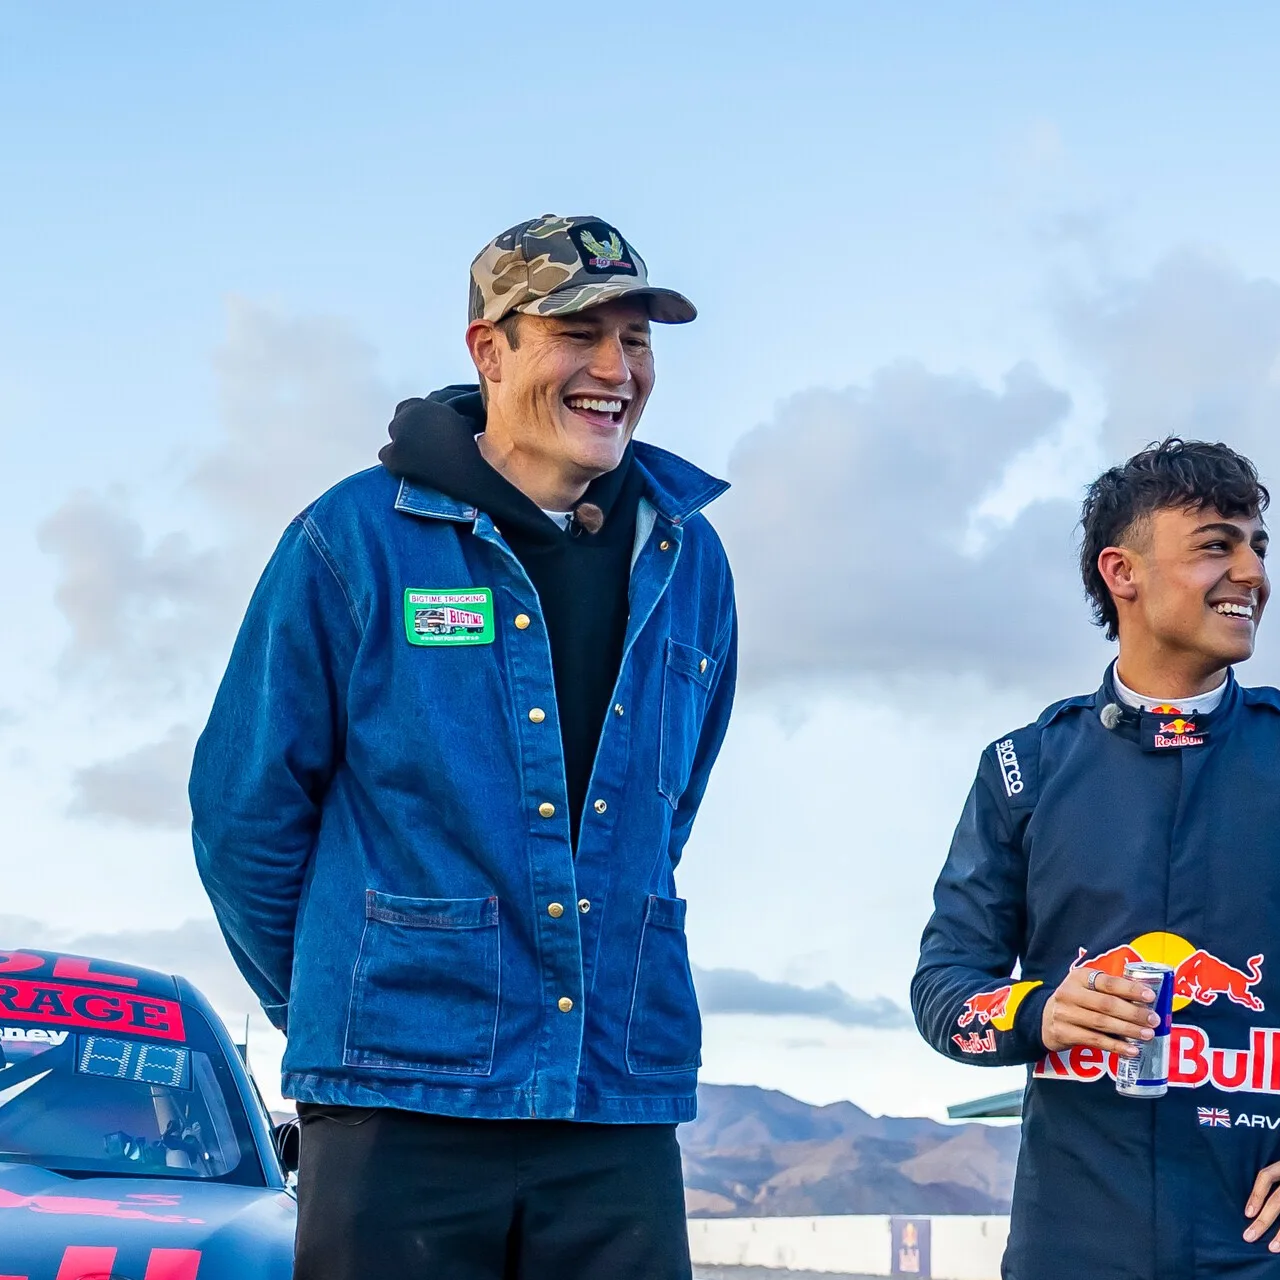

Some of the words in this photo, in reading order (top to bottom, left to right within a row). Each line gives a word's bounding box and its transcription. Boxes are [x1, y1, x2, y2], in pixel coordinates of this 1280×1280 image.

[411, 595, 441, 603] BIGTIME
[444, 594, 485, 603] TRUCKING
[449, 609, 482, 625] BIGTIME
[1154, 734, 1180, 748] Red
[995, 739, 1024, 797] sparco
